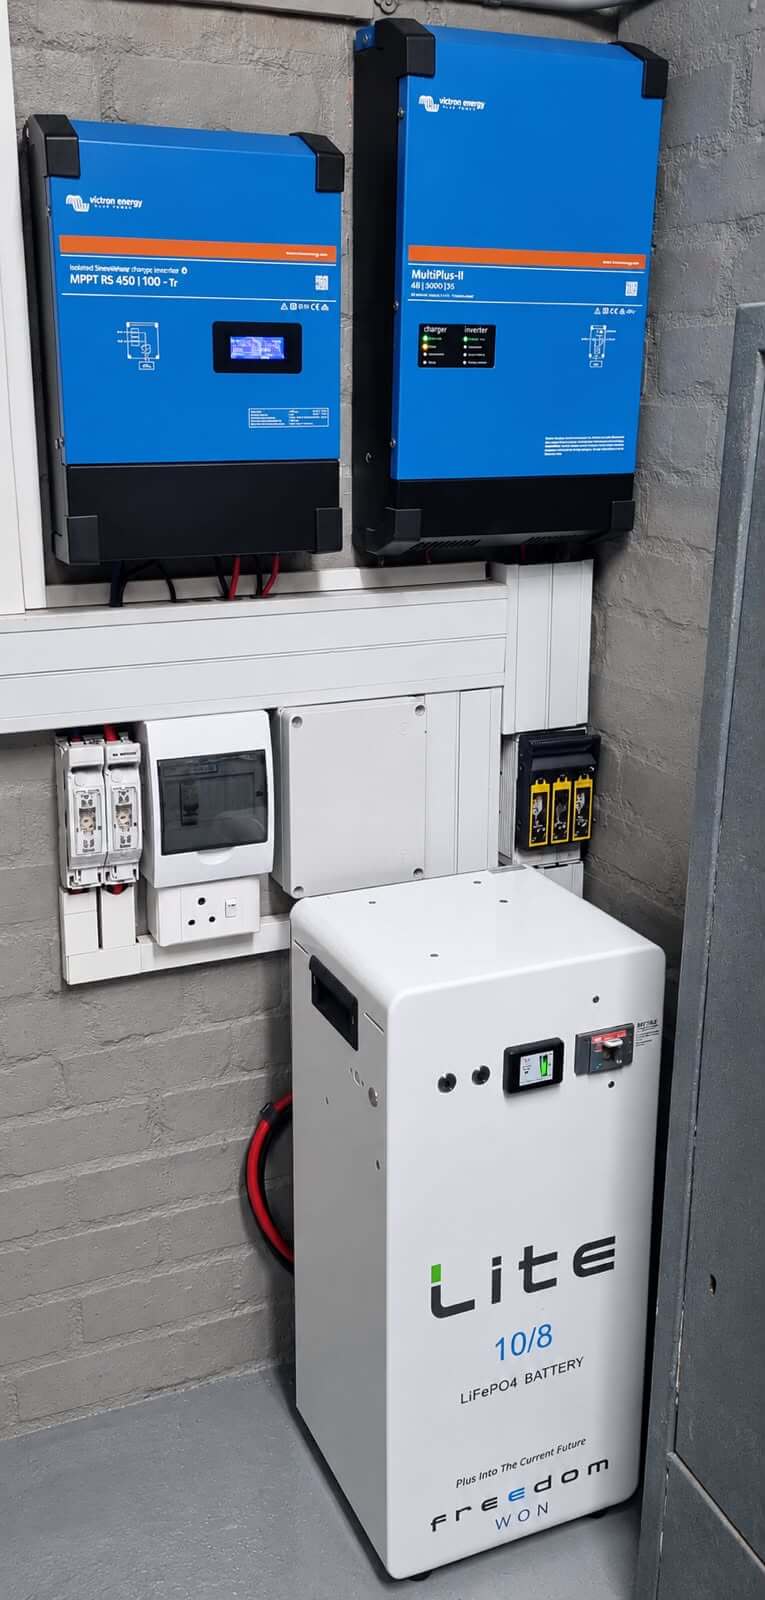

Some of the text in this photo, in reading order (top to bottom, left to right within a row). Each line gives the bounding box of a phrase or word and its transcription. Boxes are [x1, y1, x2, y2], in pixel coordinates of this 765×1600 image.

[439, 97, 461, 106] victron
[462, 100, 486, 110] energy
[90, 196, 115, 205] victron
[117, 198, 142, 208] energy
[70, 274, 99, 284] MPPT
[101, 275, 114, 285] RS
[169, 278, 178, 288] Tr
[411, 269, 464, 280] MultiPlus-II
[424, 326, 448, 335] charger
[464, 325, 488, 334] inverter
[495, 1323, 554, 1361] 10/8
[460, 1356, 585, 1405] LiFePO4 BATTERY
[456, 1437, 587, 1489] Plus Into The Current Future
[430, 1458, 609, 1532] freedom
